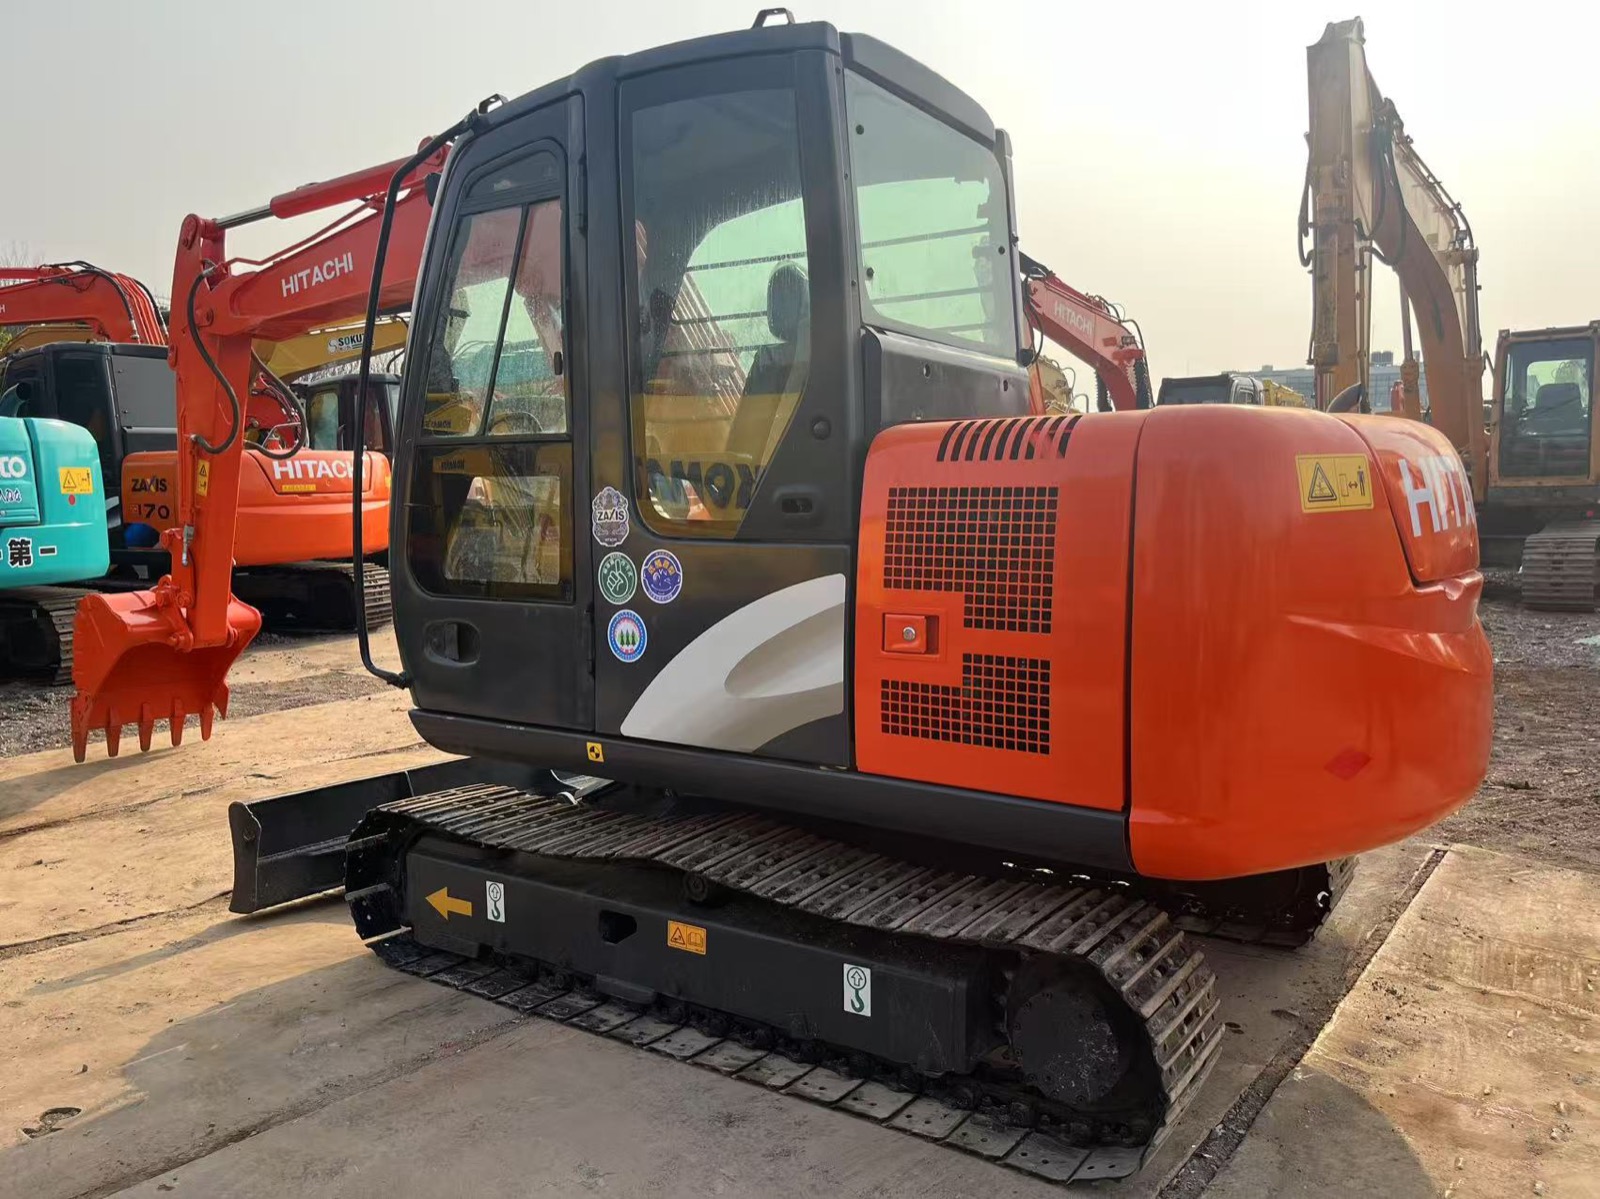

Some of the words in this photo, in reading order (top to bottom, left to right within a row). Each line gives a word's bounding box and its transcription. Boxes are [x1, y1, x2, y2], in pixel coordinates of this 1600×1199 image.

[281, 252, 354, 297] HITACHI
[1054, 301, 1093, 338] HITACHI
[337, 333, 365, 347] SOKU
[131, 475, 168, 493] ZAXIS
[597, 508, 625, 521] ZAXIS
[0, 537, 57, 568] 第一
